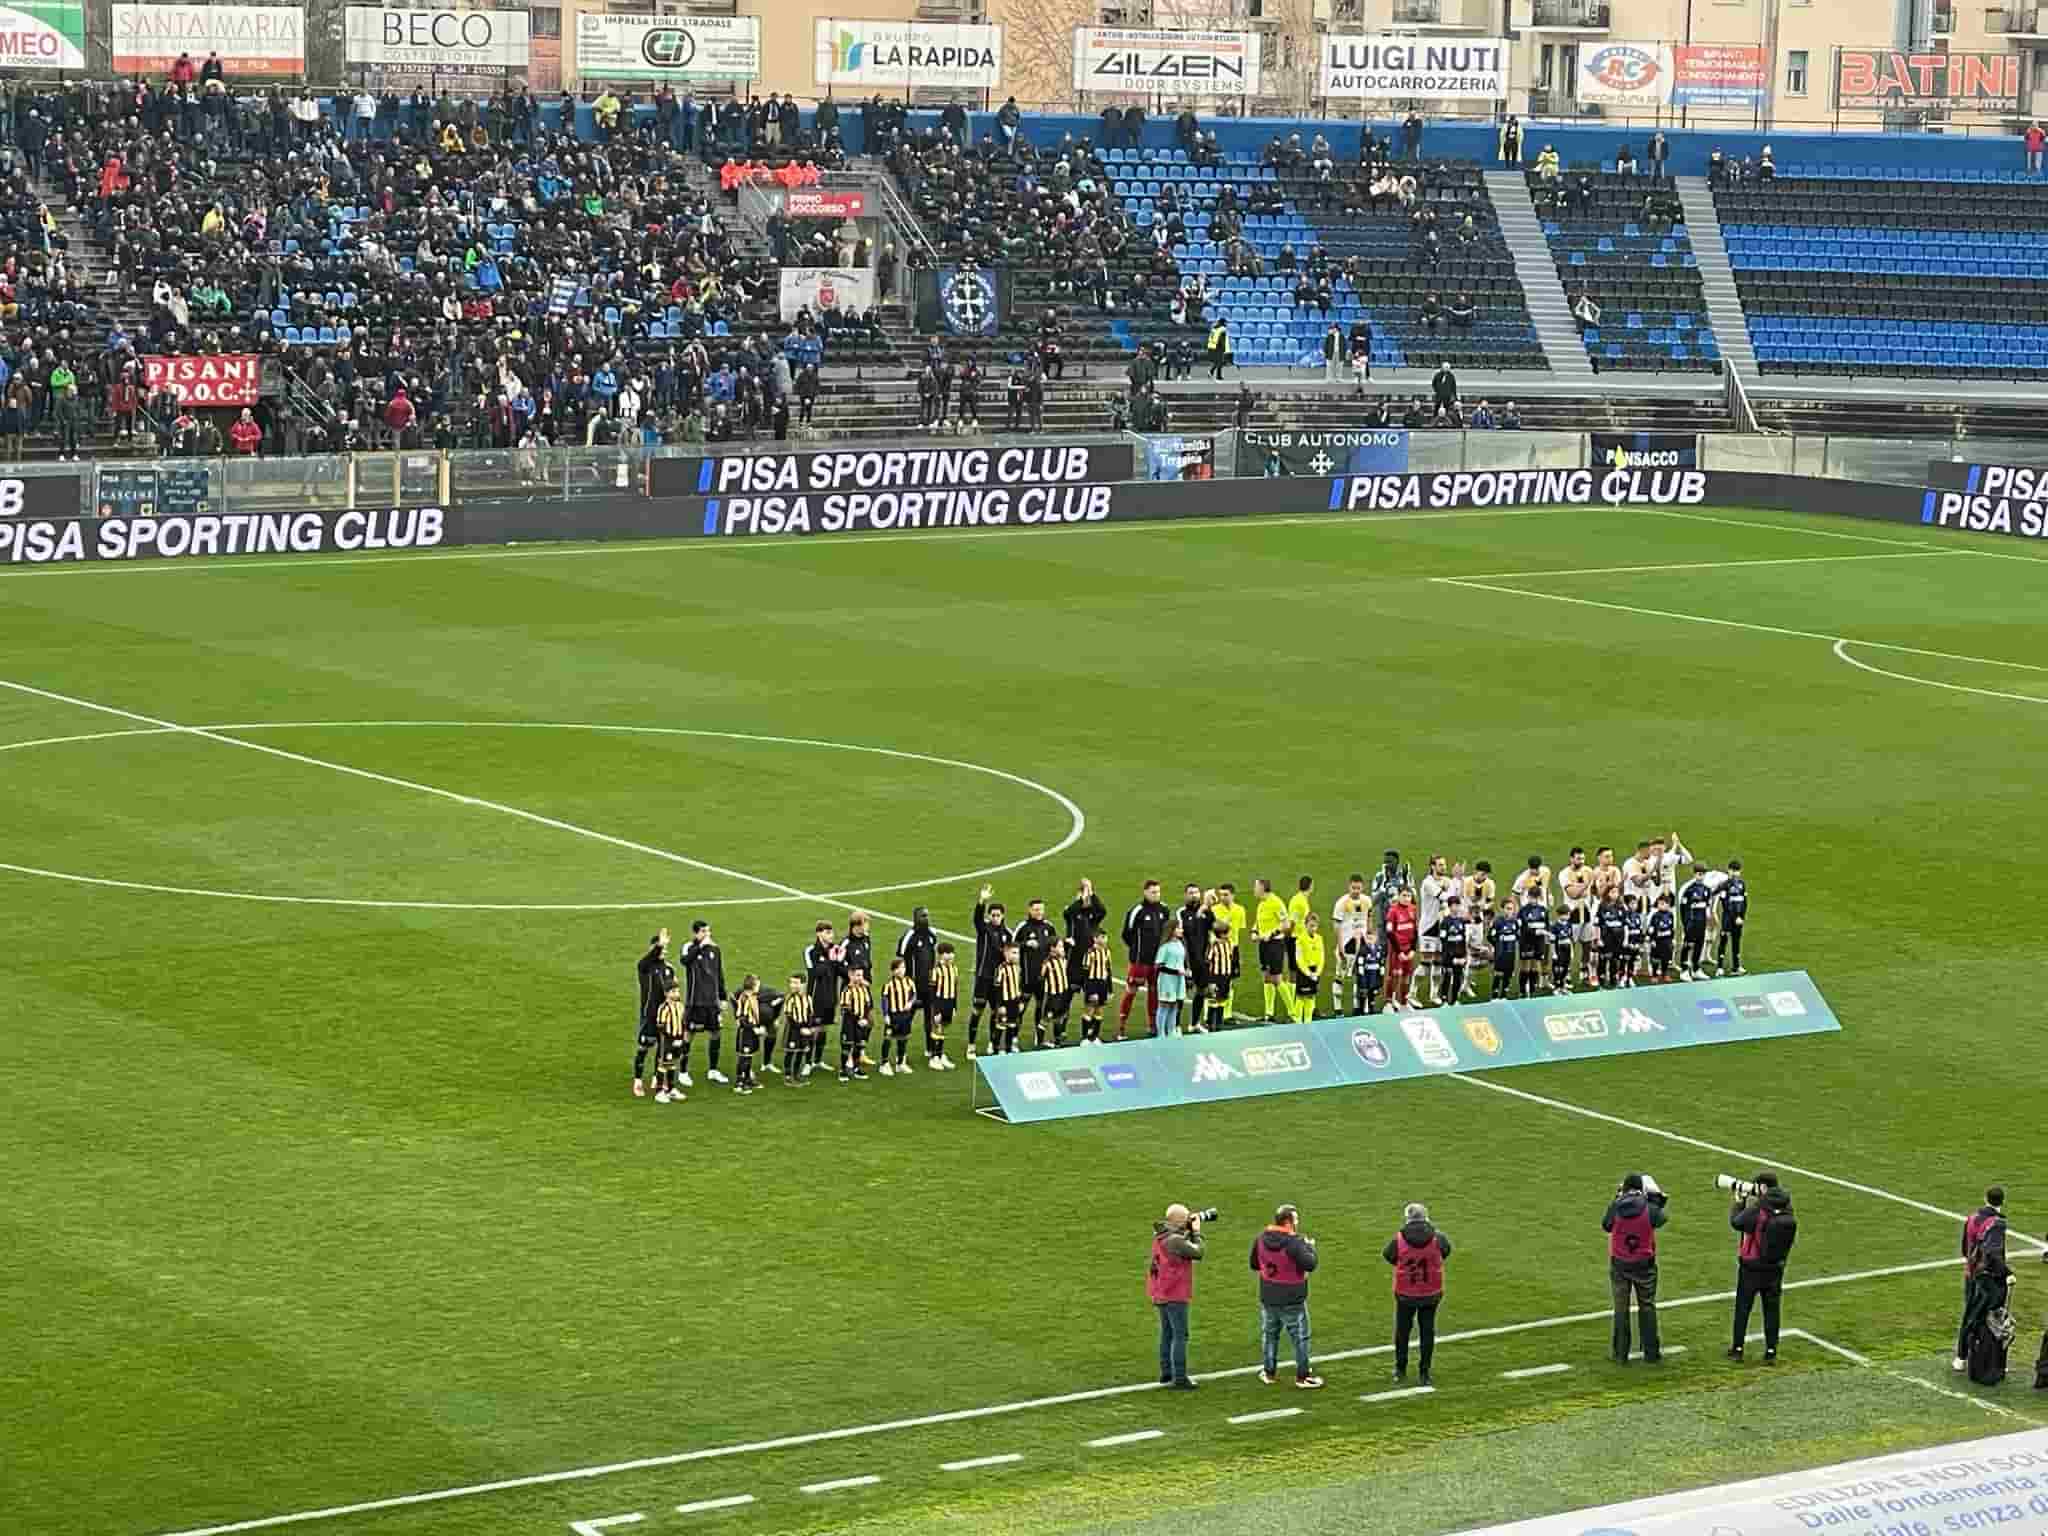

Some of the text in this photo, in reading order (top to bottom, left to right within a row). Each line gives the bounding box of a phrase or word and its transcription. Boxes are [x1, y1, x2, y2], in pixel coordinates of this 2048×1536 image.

[119, 11, 297, 40] SANTA MARIA
[384, 12, 492, 47] BECO
[604, 16, 732, 28] IMPRESA EDILE STRADALE
[873, 45, 995, 68] LA RAPIDA
[1093, 52, 1243, 78] GILGEN
[1330, 44, 1499, 72] LUIGI NUTI
[1125, 78, 1245, 91] DOOR SYSTEMS
[1330, 75, 1498, 91] AUTOCARROZZERIA
[1840, 52, 2018, 96] BATINI
[147, 360, 256, 381] PISANI
[1244, 432, 1400, 447] CLUB AUTONOMO
[718, 448, 1089, 492] PISA SPORTING CLUB
[1606, 449, 1679, 466] PNSACCO
[1347, 470, 1705, 510] PISA SPORTING CLUB
[724, 487, 1112, 534] PISA SPORTING CLUB
[1939, 493, 2048, 537] PISA S
[97, 513, 323, 559] SPORTING
[334, 508, 443, 549] CLUB
[1776, 1478, 1894, 1512] EDILIZIA
[1920, 1462, 1992, 1484] NON
[1987, 1449, 2048, 1472] SOL
[1795, 1504, 1873, 1529] Dalle
[1872, 1474, 2037, 1514] fondamenta
[1943, 1503, 2024, 1530] senza
